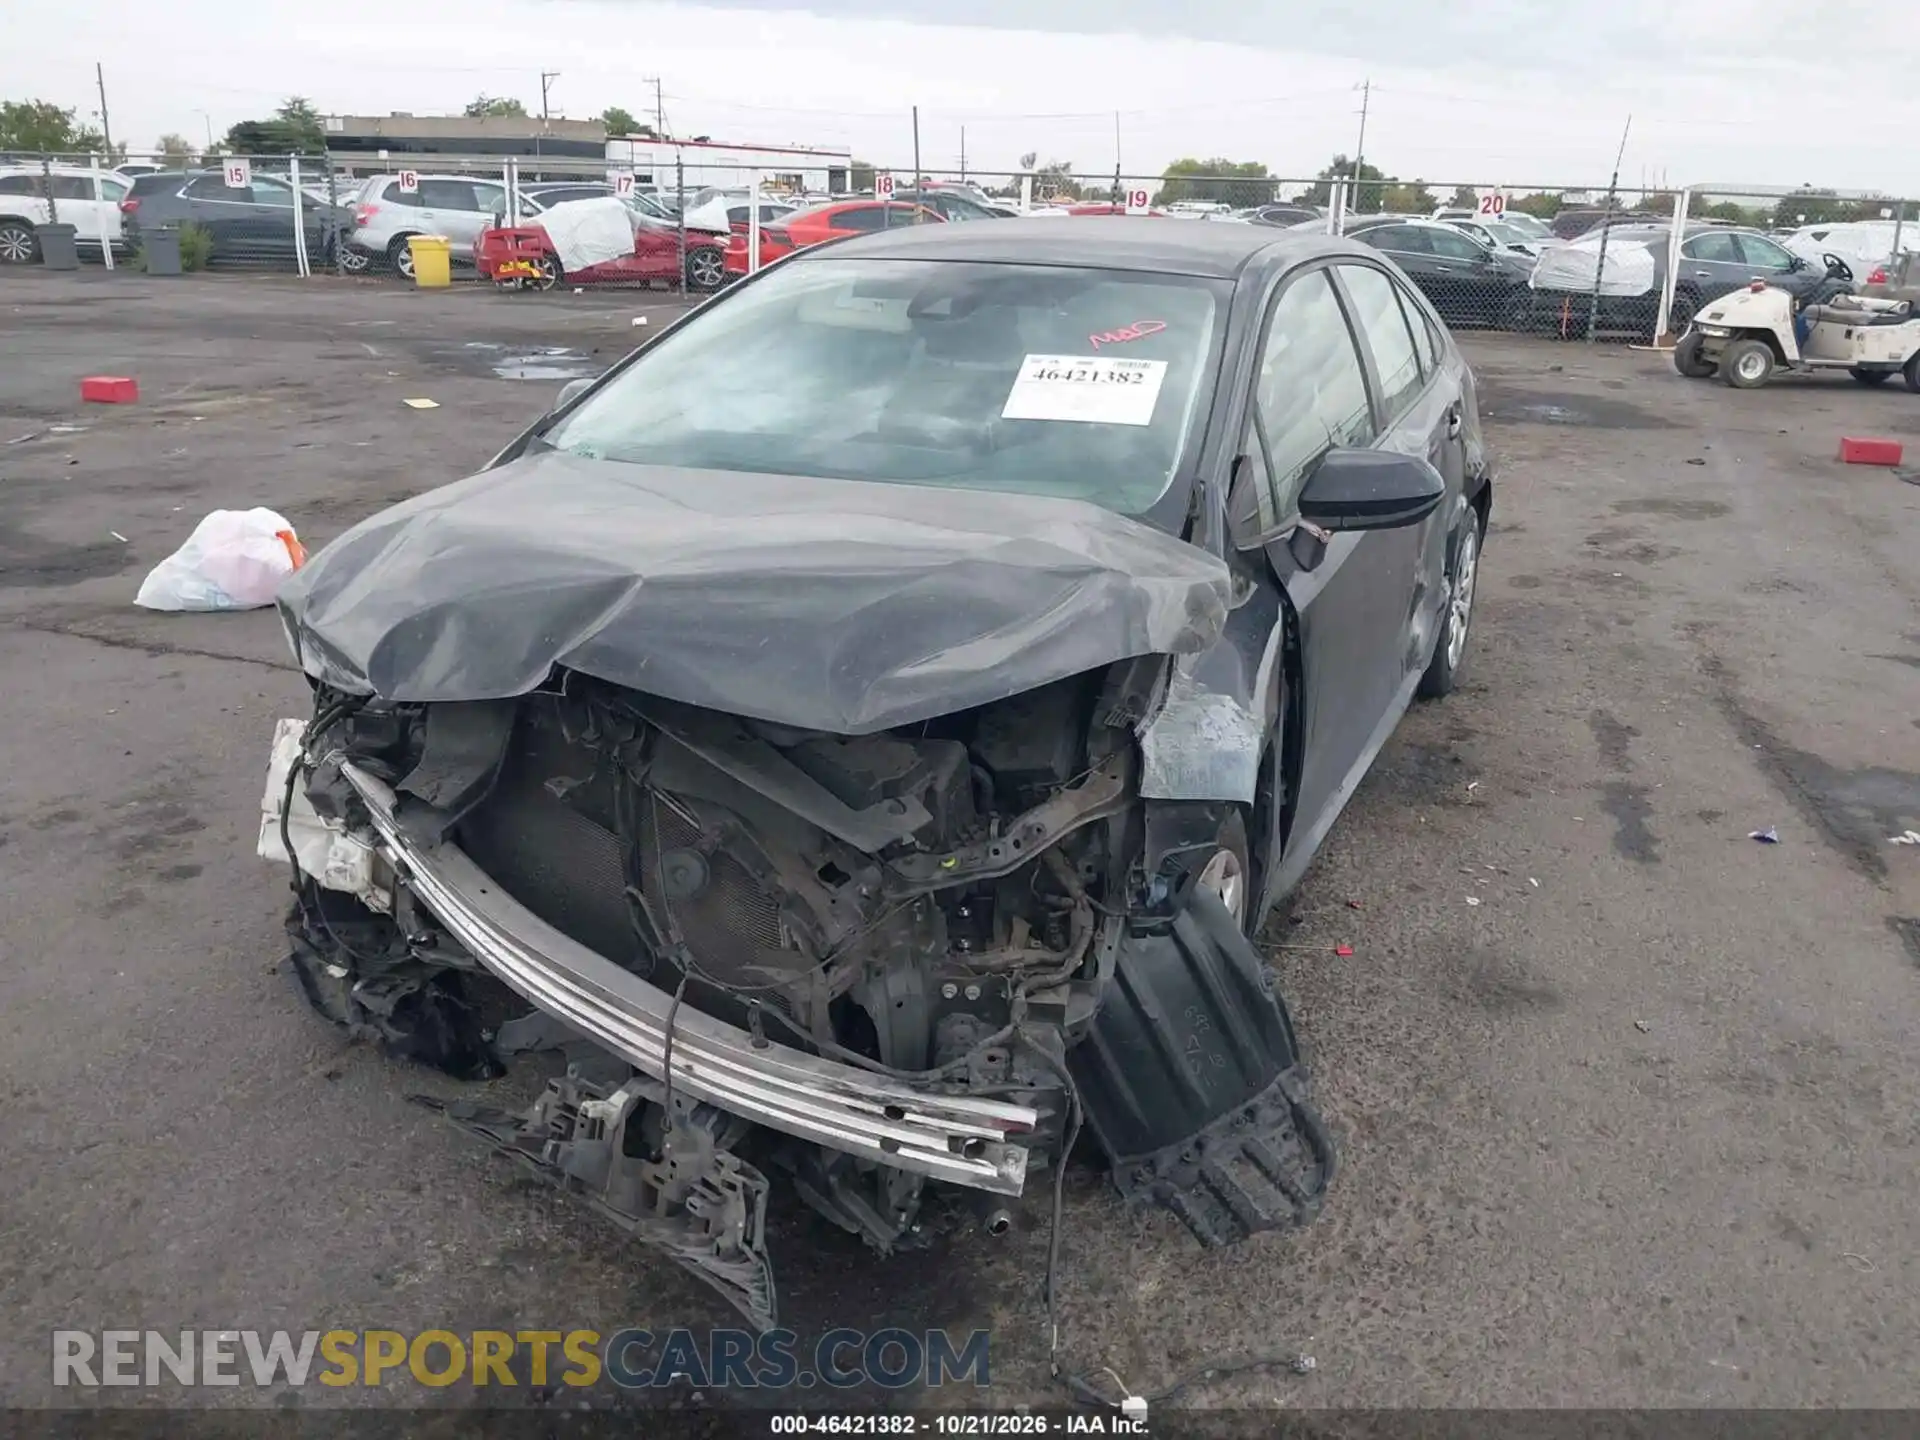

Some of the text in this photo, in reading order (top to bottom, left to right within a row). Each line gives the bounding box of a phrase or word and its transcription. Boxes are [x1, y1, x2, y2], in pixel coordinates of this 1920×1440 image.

[229, 168, 243, 183] 15
[401, 172, 415, 187] 16
[617, 177, 633, 192] 17
[877, 177, 893, 193] 18
[1128, 191, 1147, 207] 19
[1482, 196, 1503, 214] 20
[1032, 367, 1144, 384] 46421382
